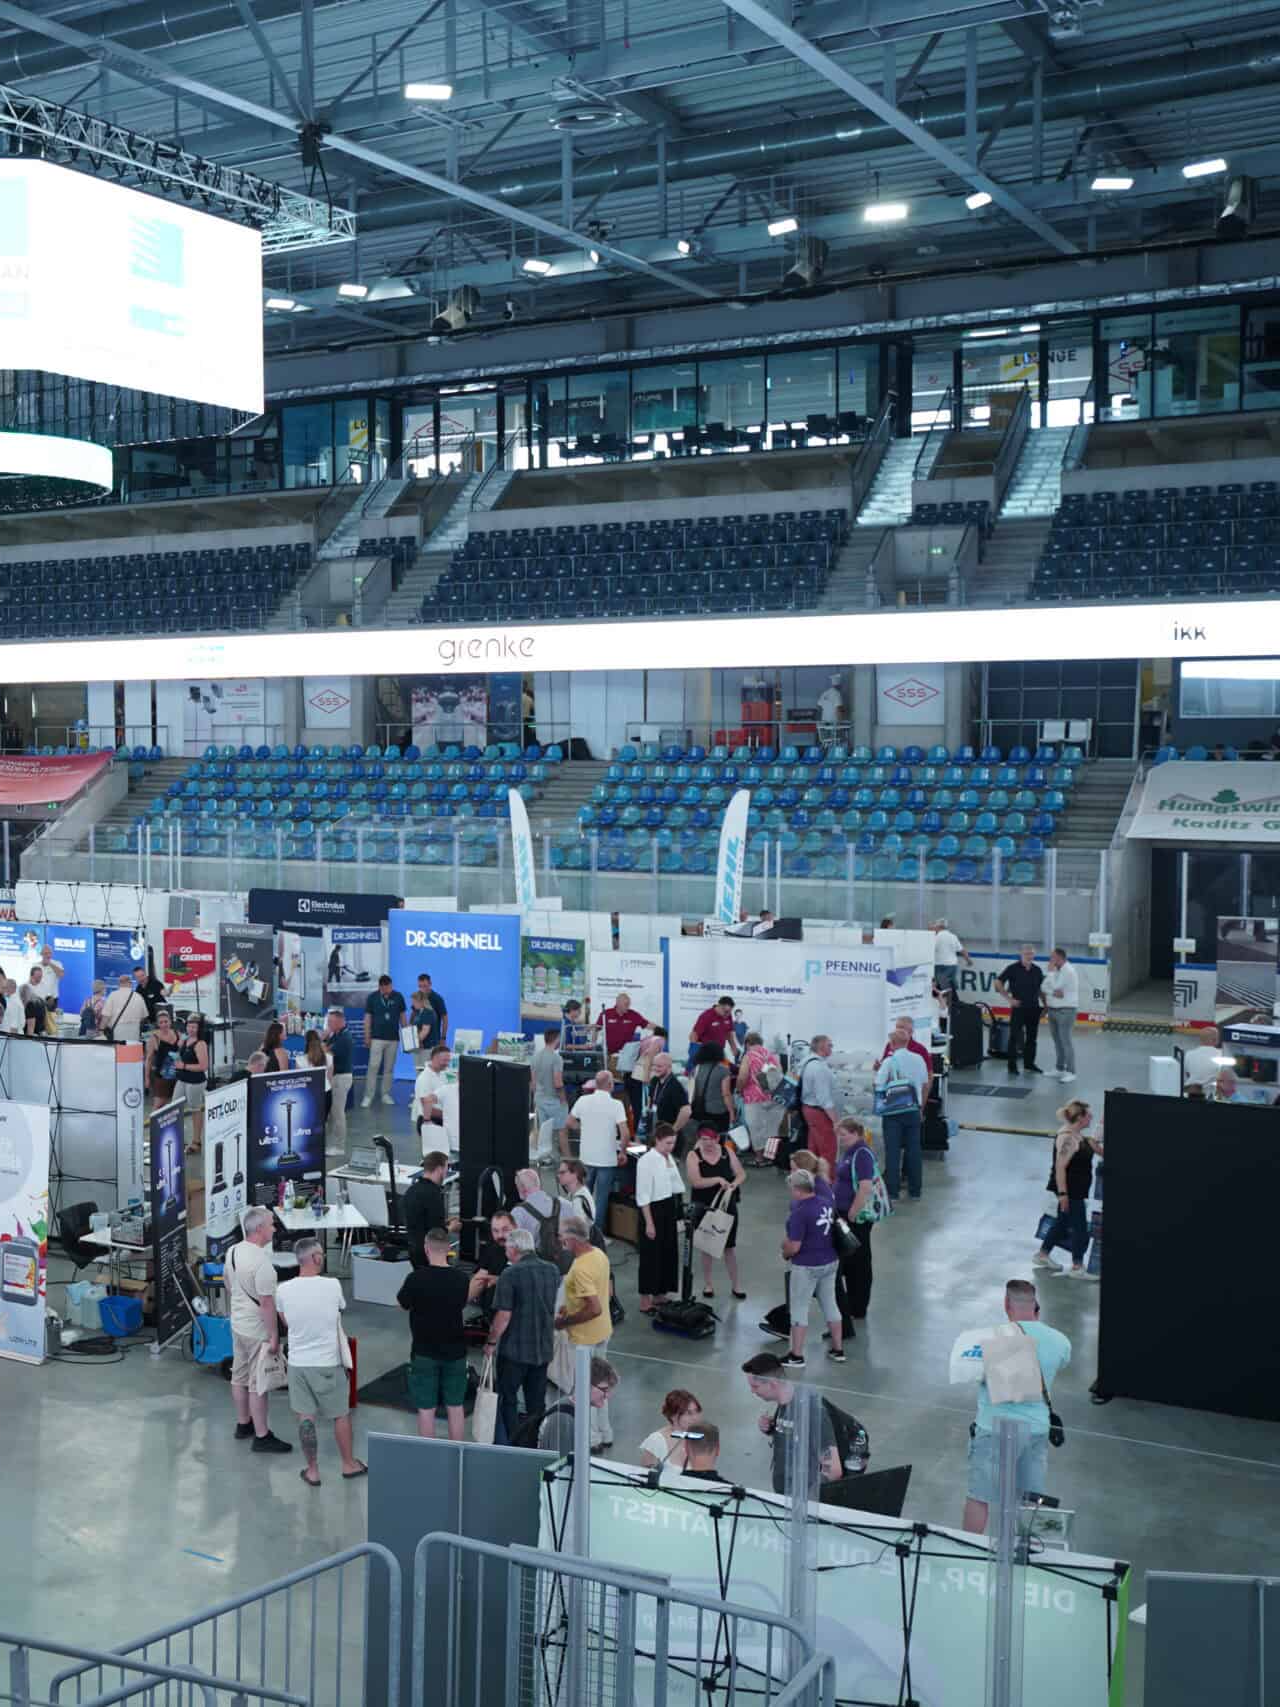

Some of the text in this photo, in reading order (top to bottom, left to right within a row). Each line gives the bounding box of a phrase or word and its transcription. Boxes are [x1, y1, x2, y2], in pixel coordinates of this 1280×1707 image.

[438, 634, 535, 666] grenke
[896, 687, 927, 698] SSS
[317, 696, 341, 706] SSS
[311, 901, 345, 910] Electrolux
[825, 960, 881, 973] PFENNIG
[680, 980, 699, 990] Wer
[700, 981, 734, 993] System
